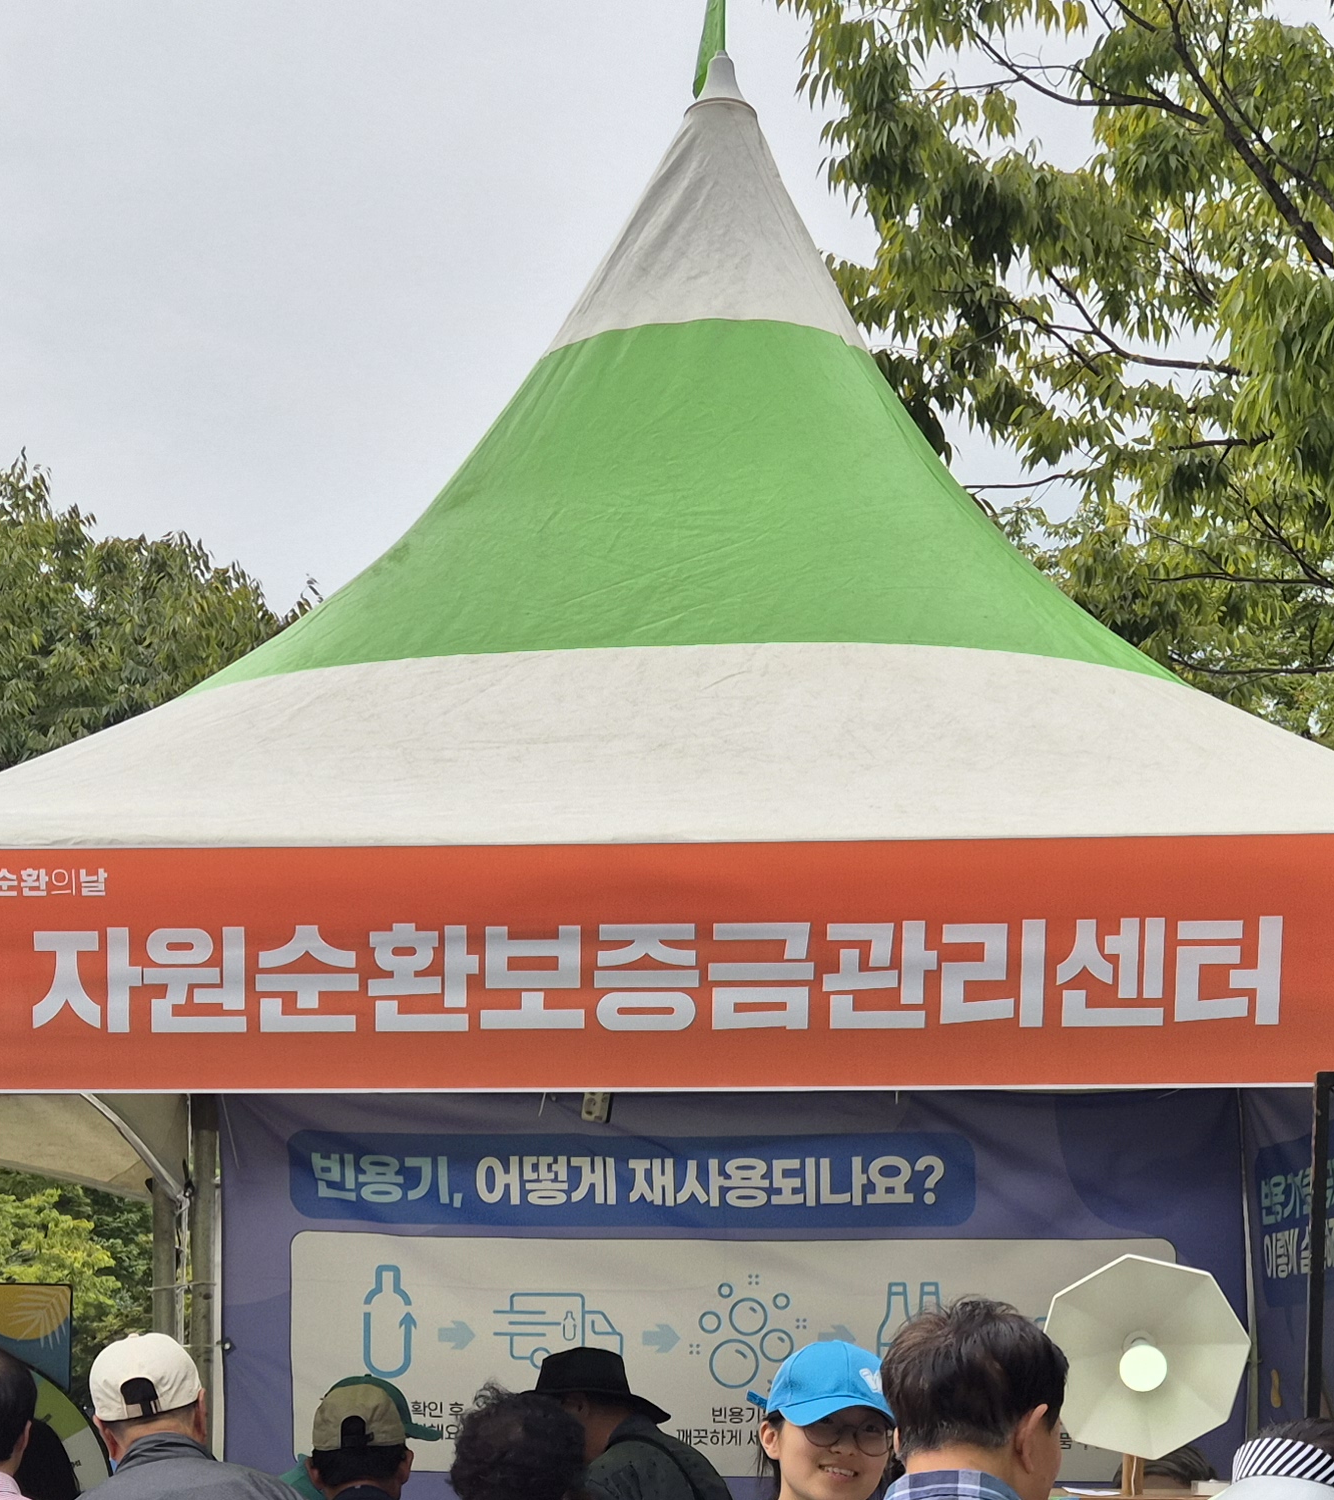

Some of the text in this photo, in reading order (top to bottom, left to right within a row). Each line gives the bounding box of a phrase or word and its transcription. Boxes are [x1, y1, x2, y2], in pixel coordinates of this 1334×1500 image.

[32, 913, 1284, 1034] 자원순환보증금관리센터
[309, 1151, 947, 1210] 빈용기, 어떻게 재사용되나요?
[676, 1428, 742, 1446] 깨끗하게
